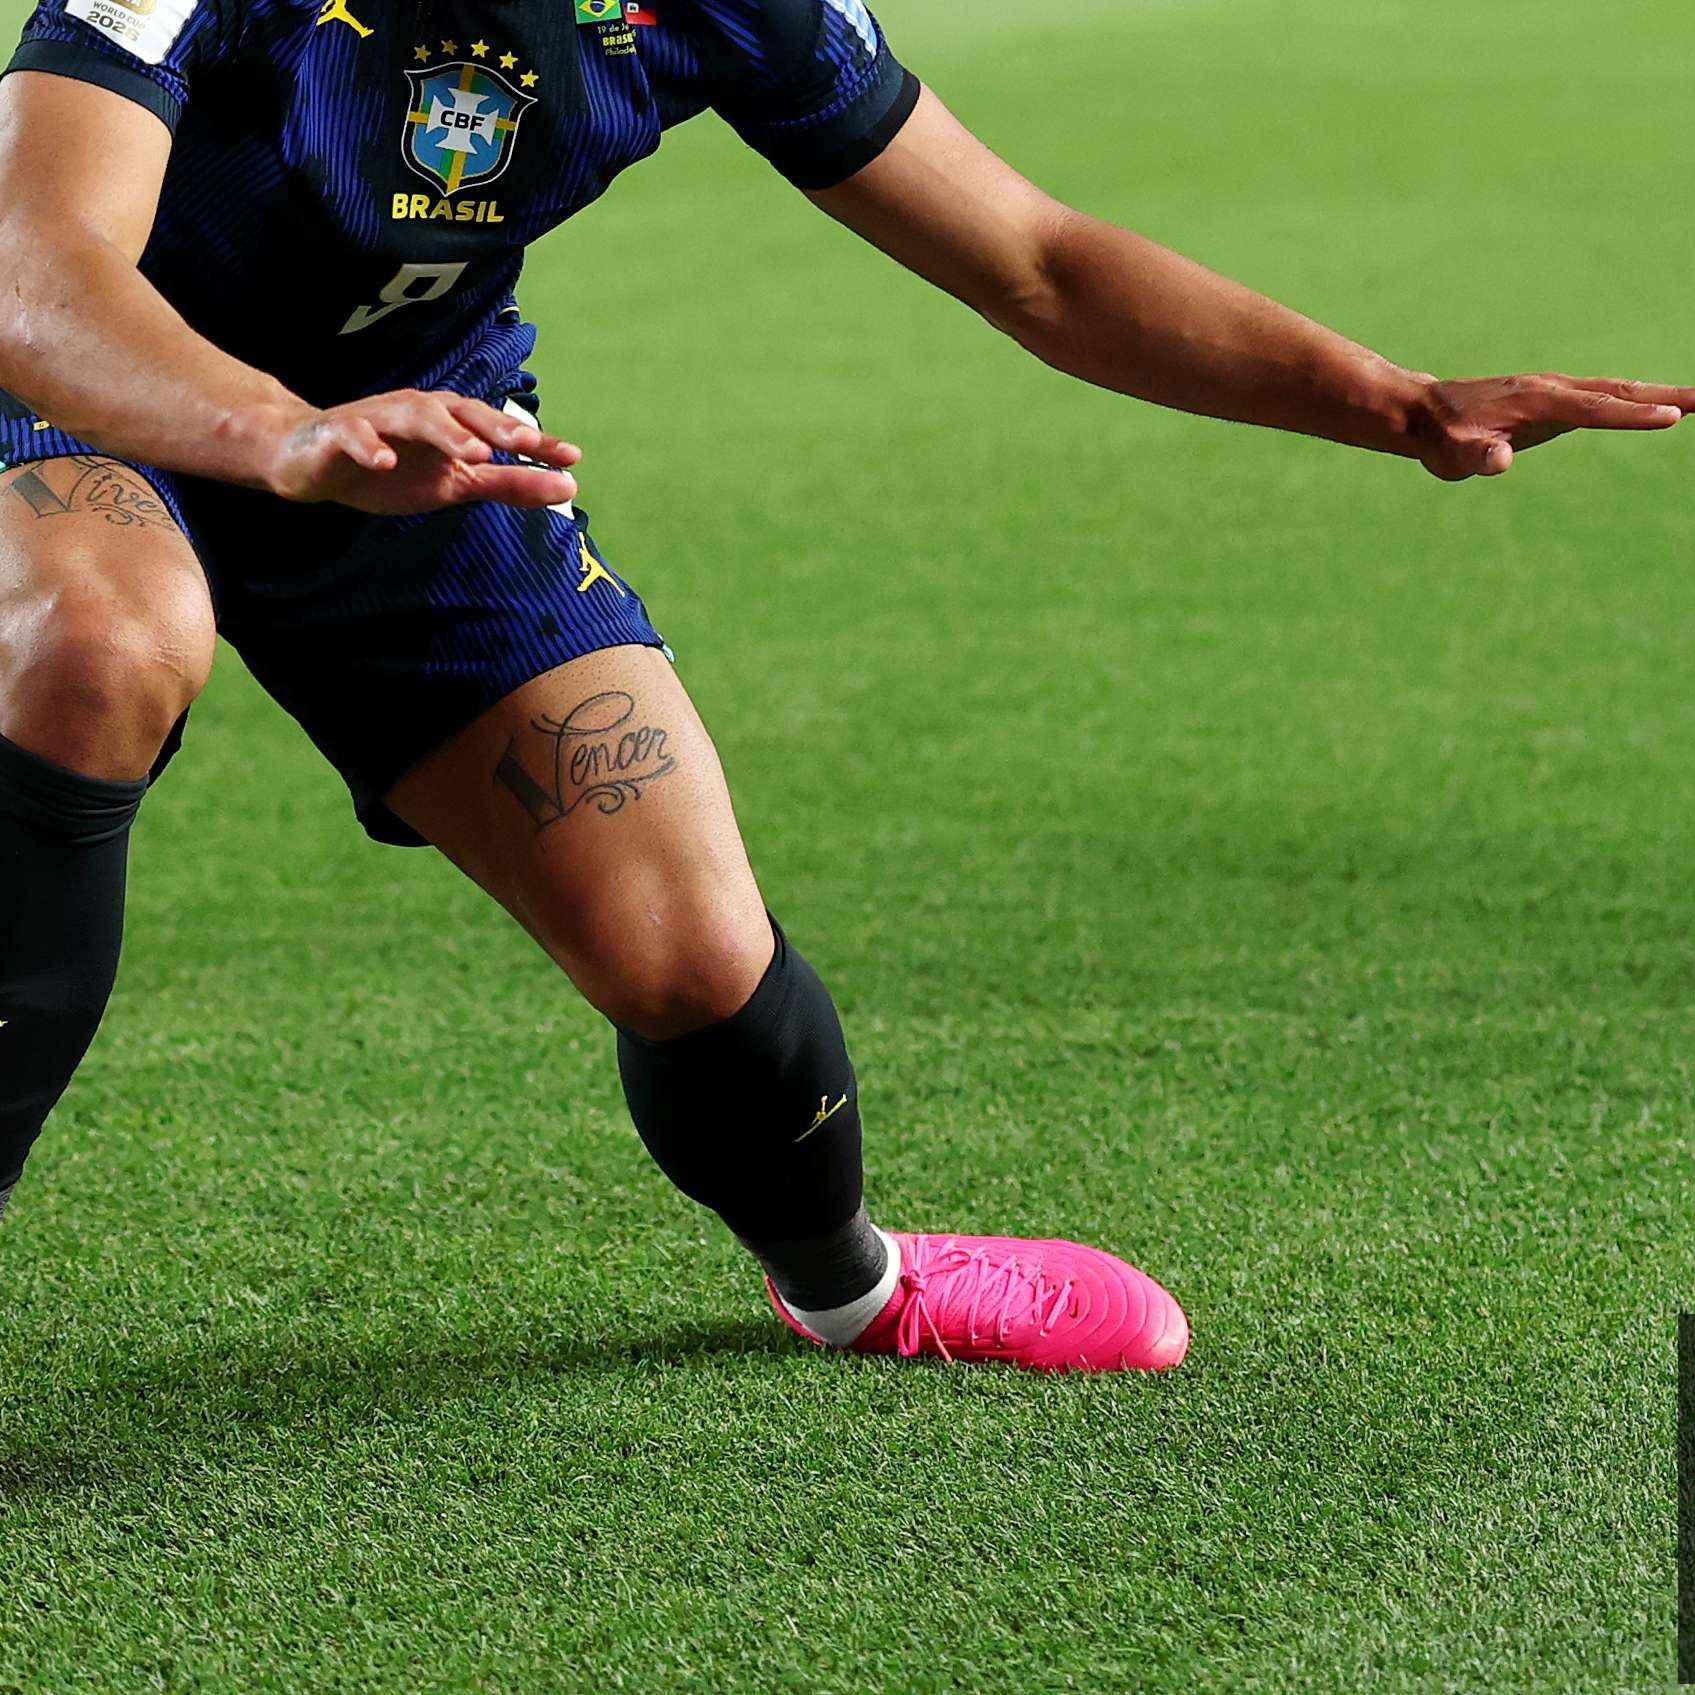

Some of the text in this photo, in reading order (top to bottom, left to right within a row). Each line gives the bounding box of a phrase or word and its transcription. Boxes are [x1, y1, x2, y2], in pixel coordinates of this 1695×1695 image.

[93, 0, 127, 20] WORLD
[440, 109, 486, 132] CBF
[391, 192, 505, 224] BRASIL
[336, 261, 470, 336] 9
